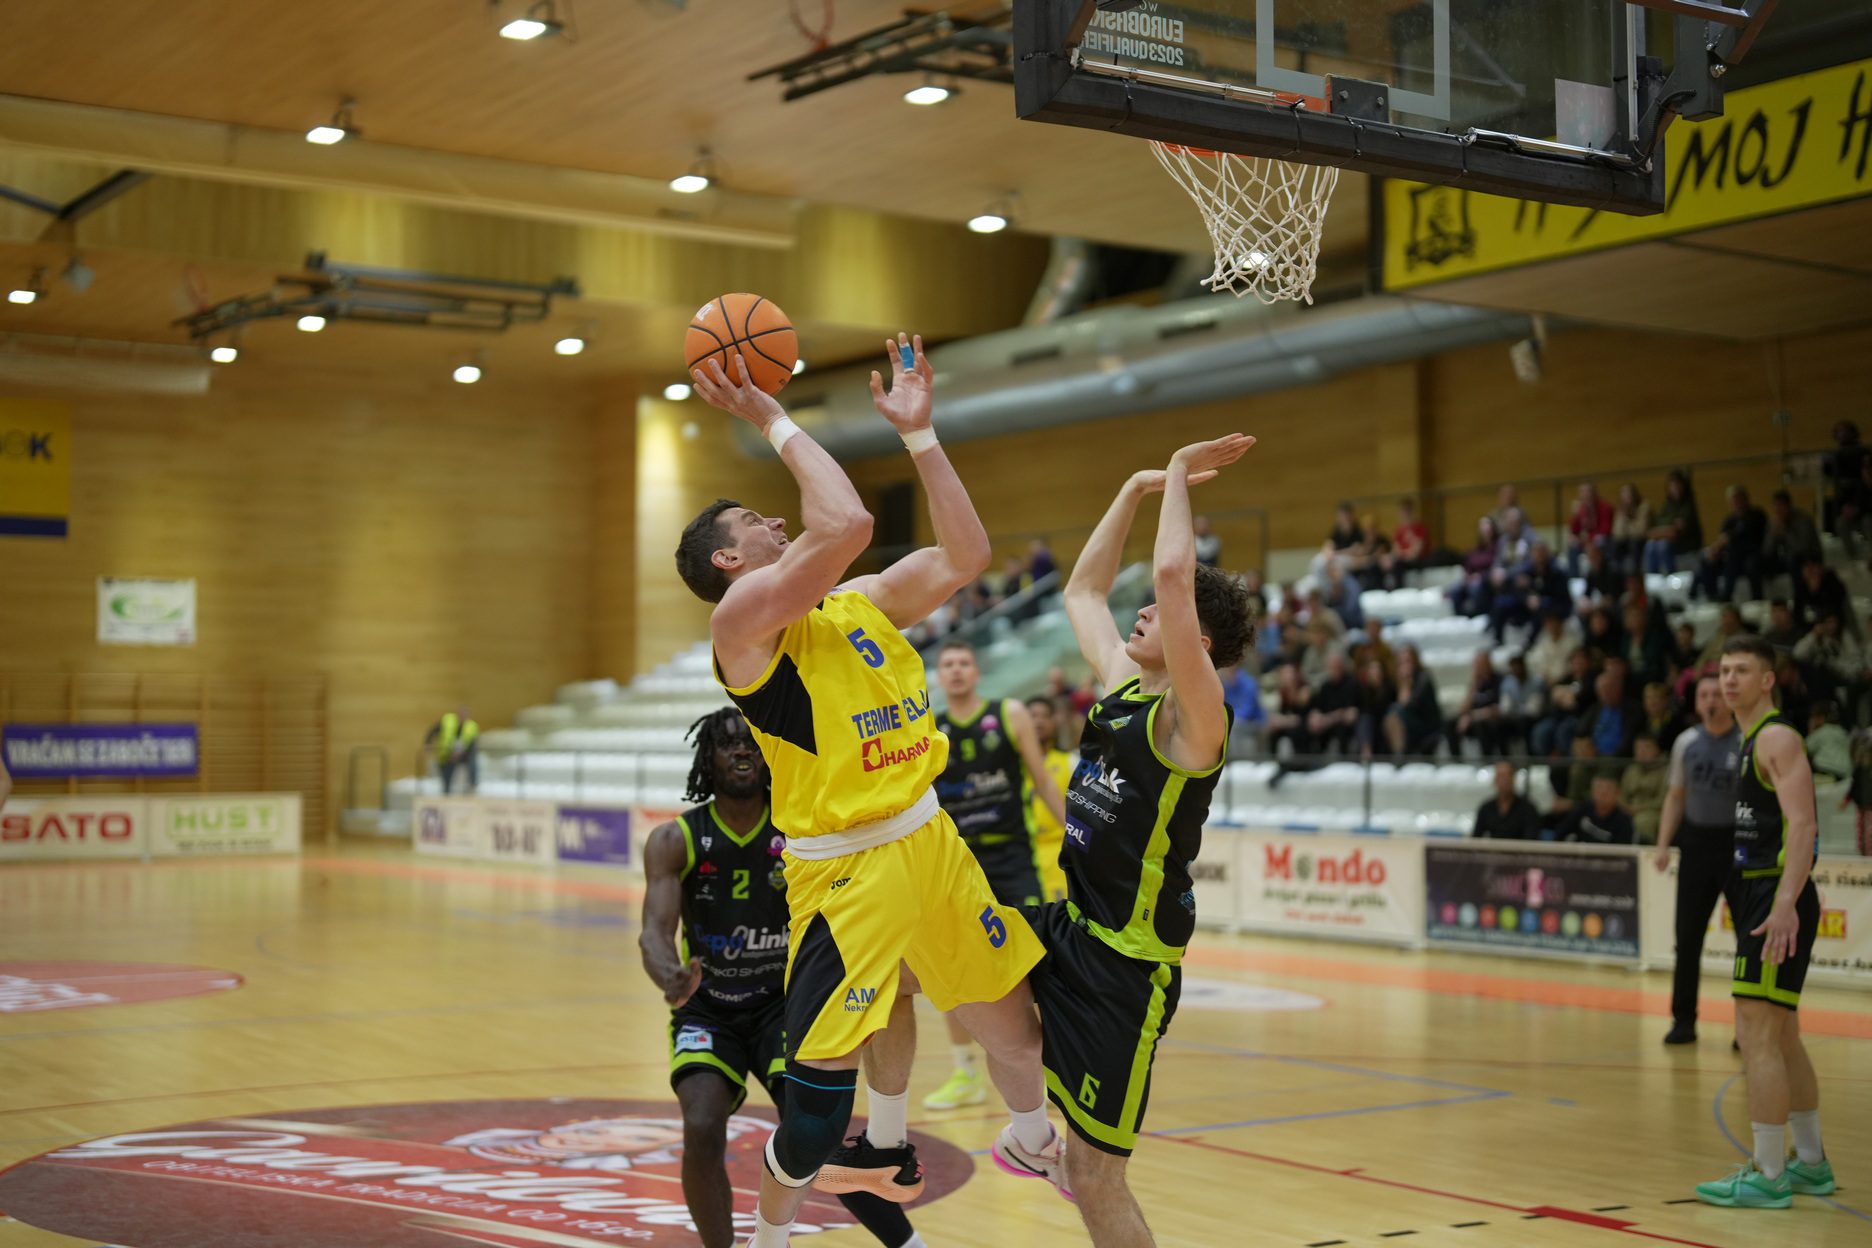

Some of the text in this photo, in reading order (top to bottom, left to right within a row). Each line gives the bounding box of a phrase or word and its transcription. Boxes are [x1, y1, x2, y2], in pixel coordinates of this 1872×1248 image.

[1665, 97, 1813, 216] MOJ
[846, 627, 885, 669] 5
[851, 704, 902, 739] TERME
[1, 813, 133, 842] SATO
[732, 869, 750, 900] 2
[978, 905, 1007, 949] 5
[1734, 956, 1747, 979] 11
[1079, 1072, 1101, 1110] 6
